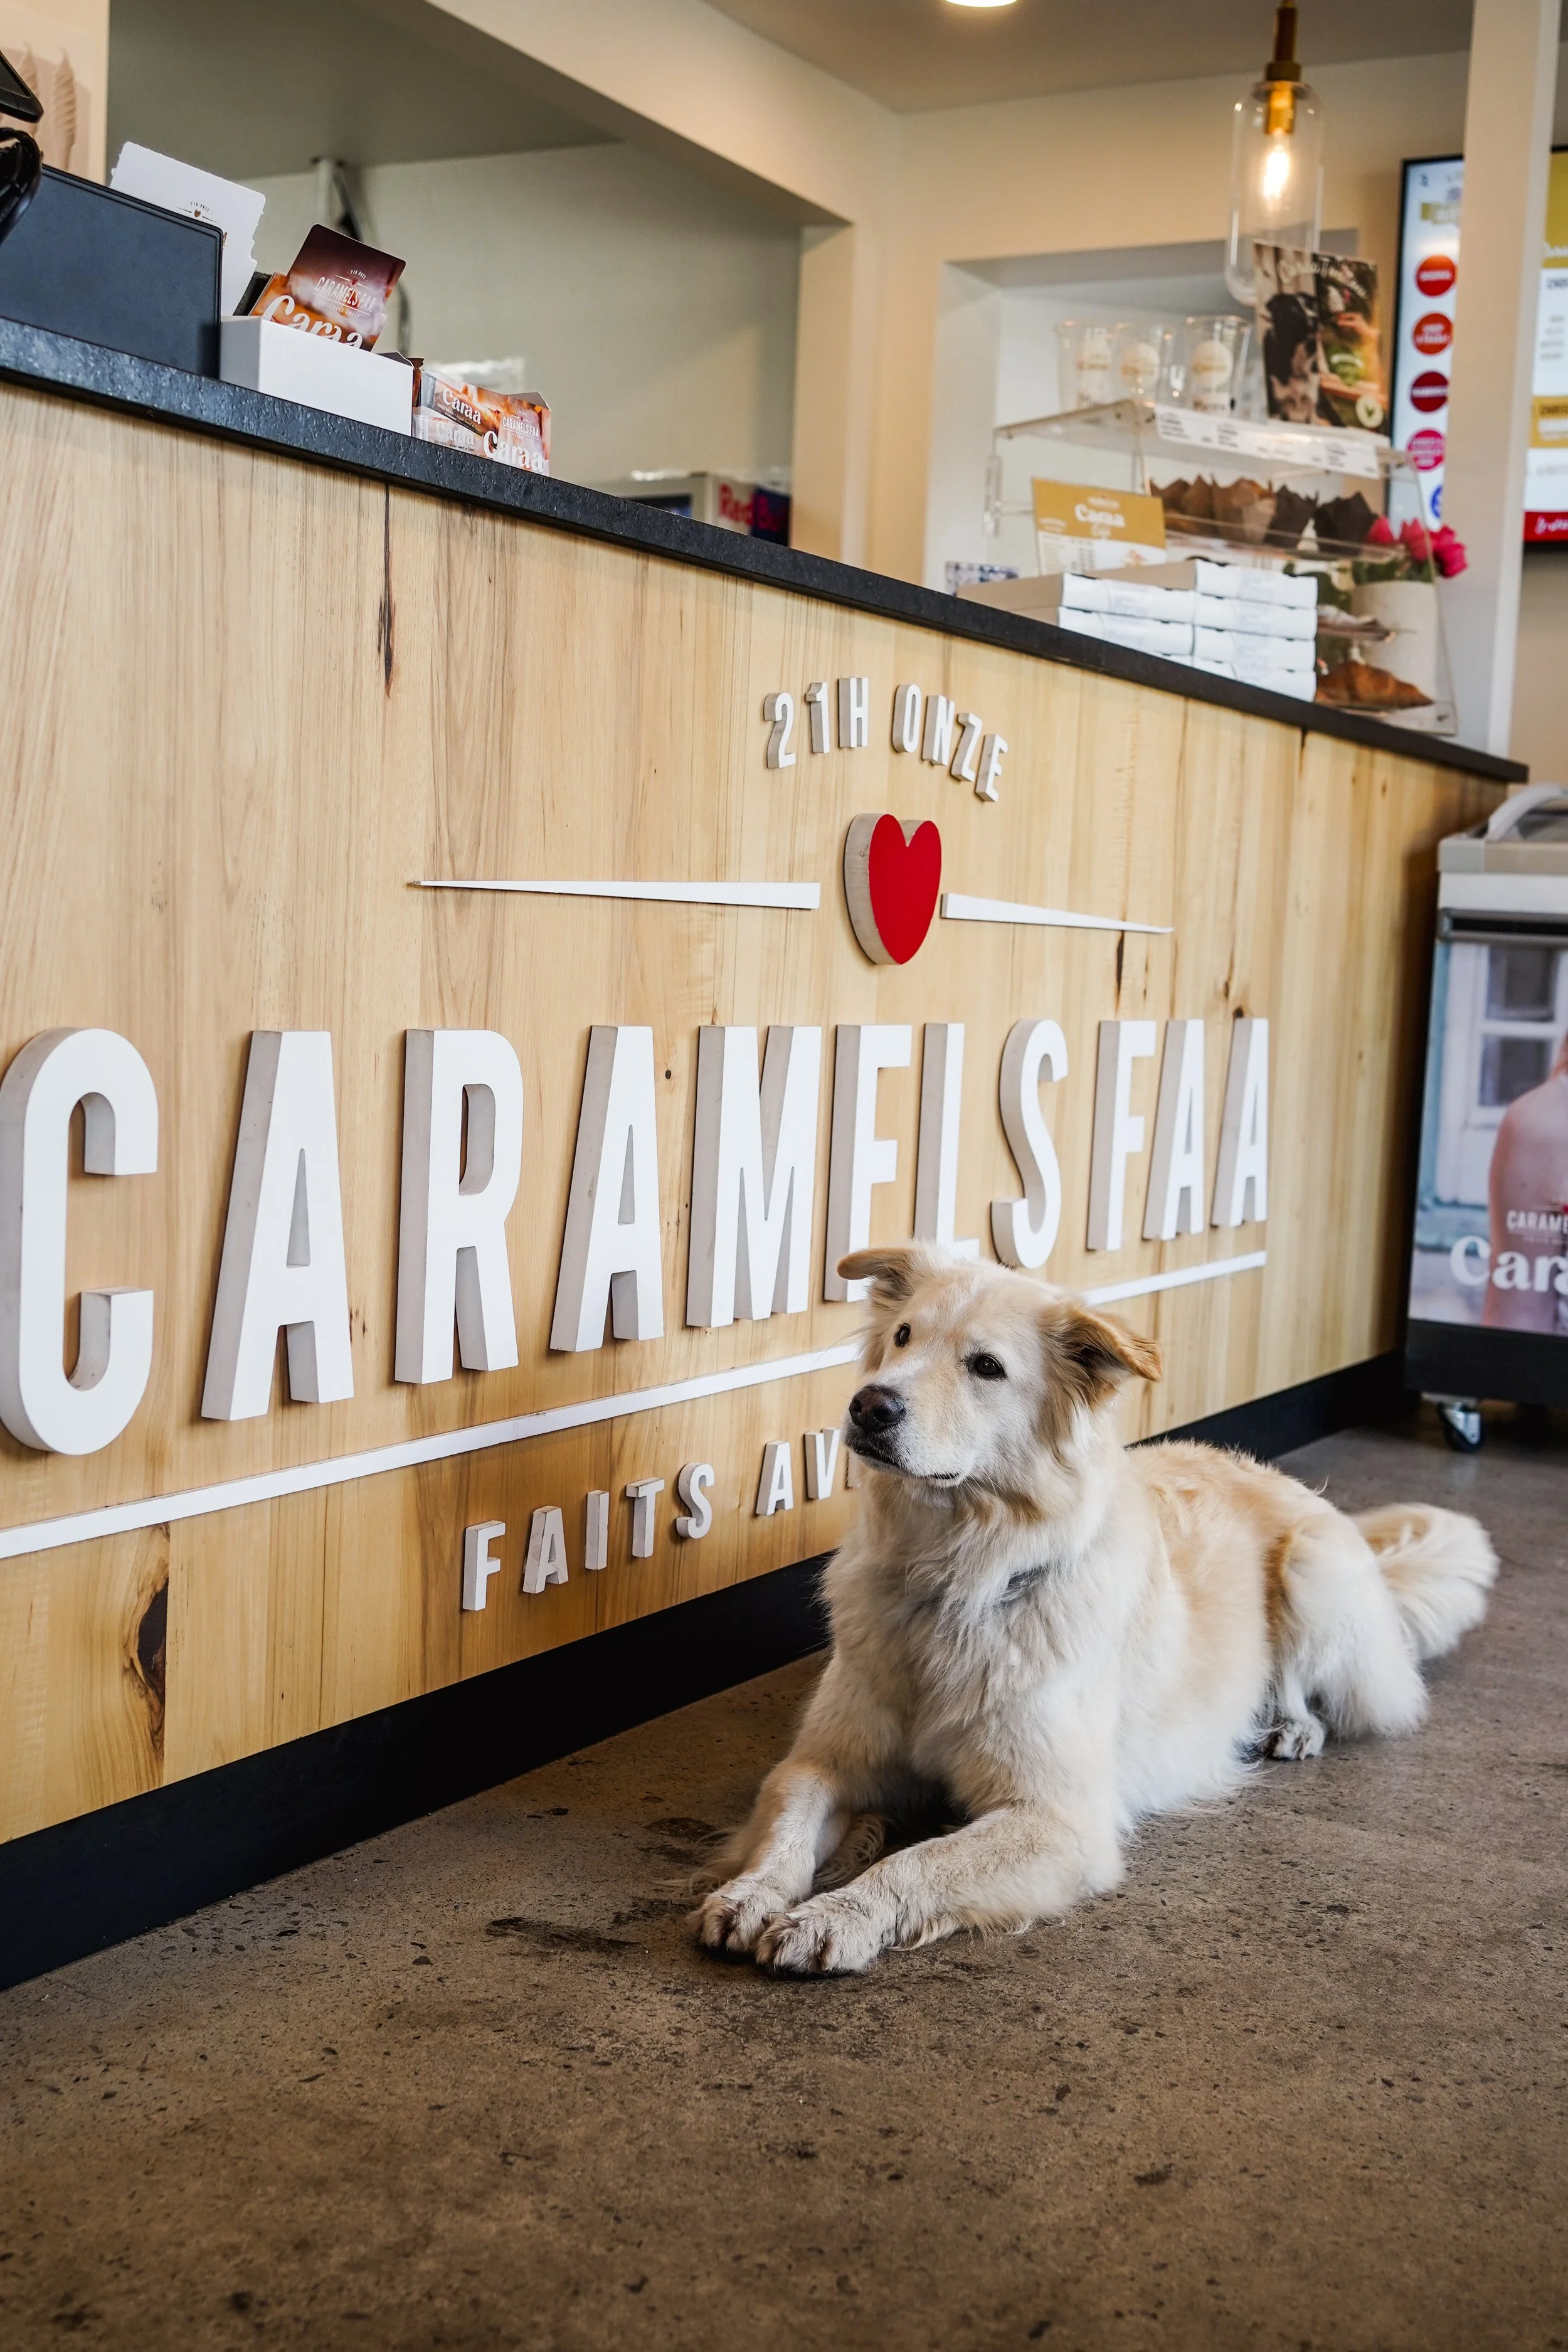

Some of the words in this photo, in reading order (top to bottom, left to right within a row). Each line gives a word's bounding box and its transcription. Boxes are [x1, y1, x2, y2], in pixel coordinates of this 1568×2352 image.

[315, 277, 361, 306] CARAMELS
[357, 294, 377, 312] FAA
[442, 388, 481, 425] Caraa
[435, 421, 475, 446] Caraa
[502, 416, 530, 435] CARAMELS
[529, 426, 539, 438] FAA
[483, 430, 544, 472] Caraa
[763, 677, 869, 769] 21H
[891, 684, 1009, 803] ONZE
[0, 1019, 1068, 1456] CARAMELS
[1086, 1017, 1269, 1253] FAA
[462, 1462, 715, 1612] FAITS
